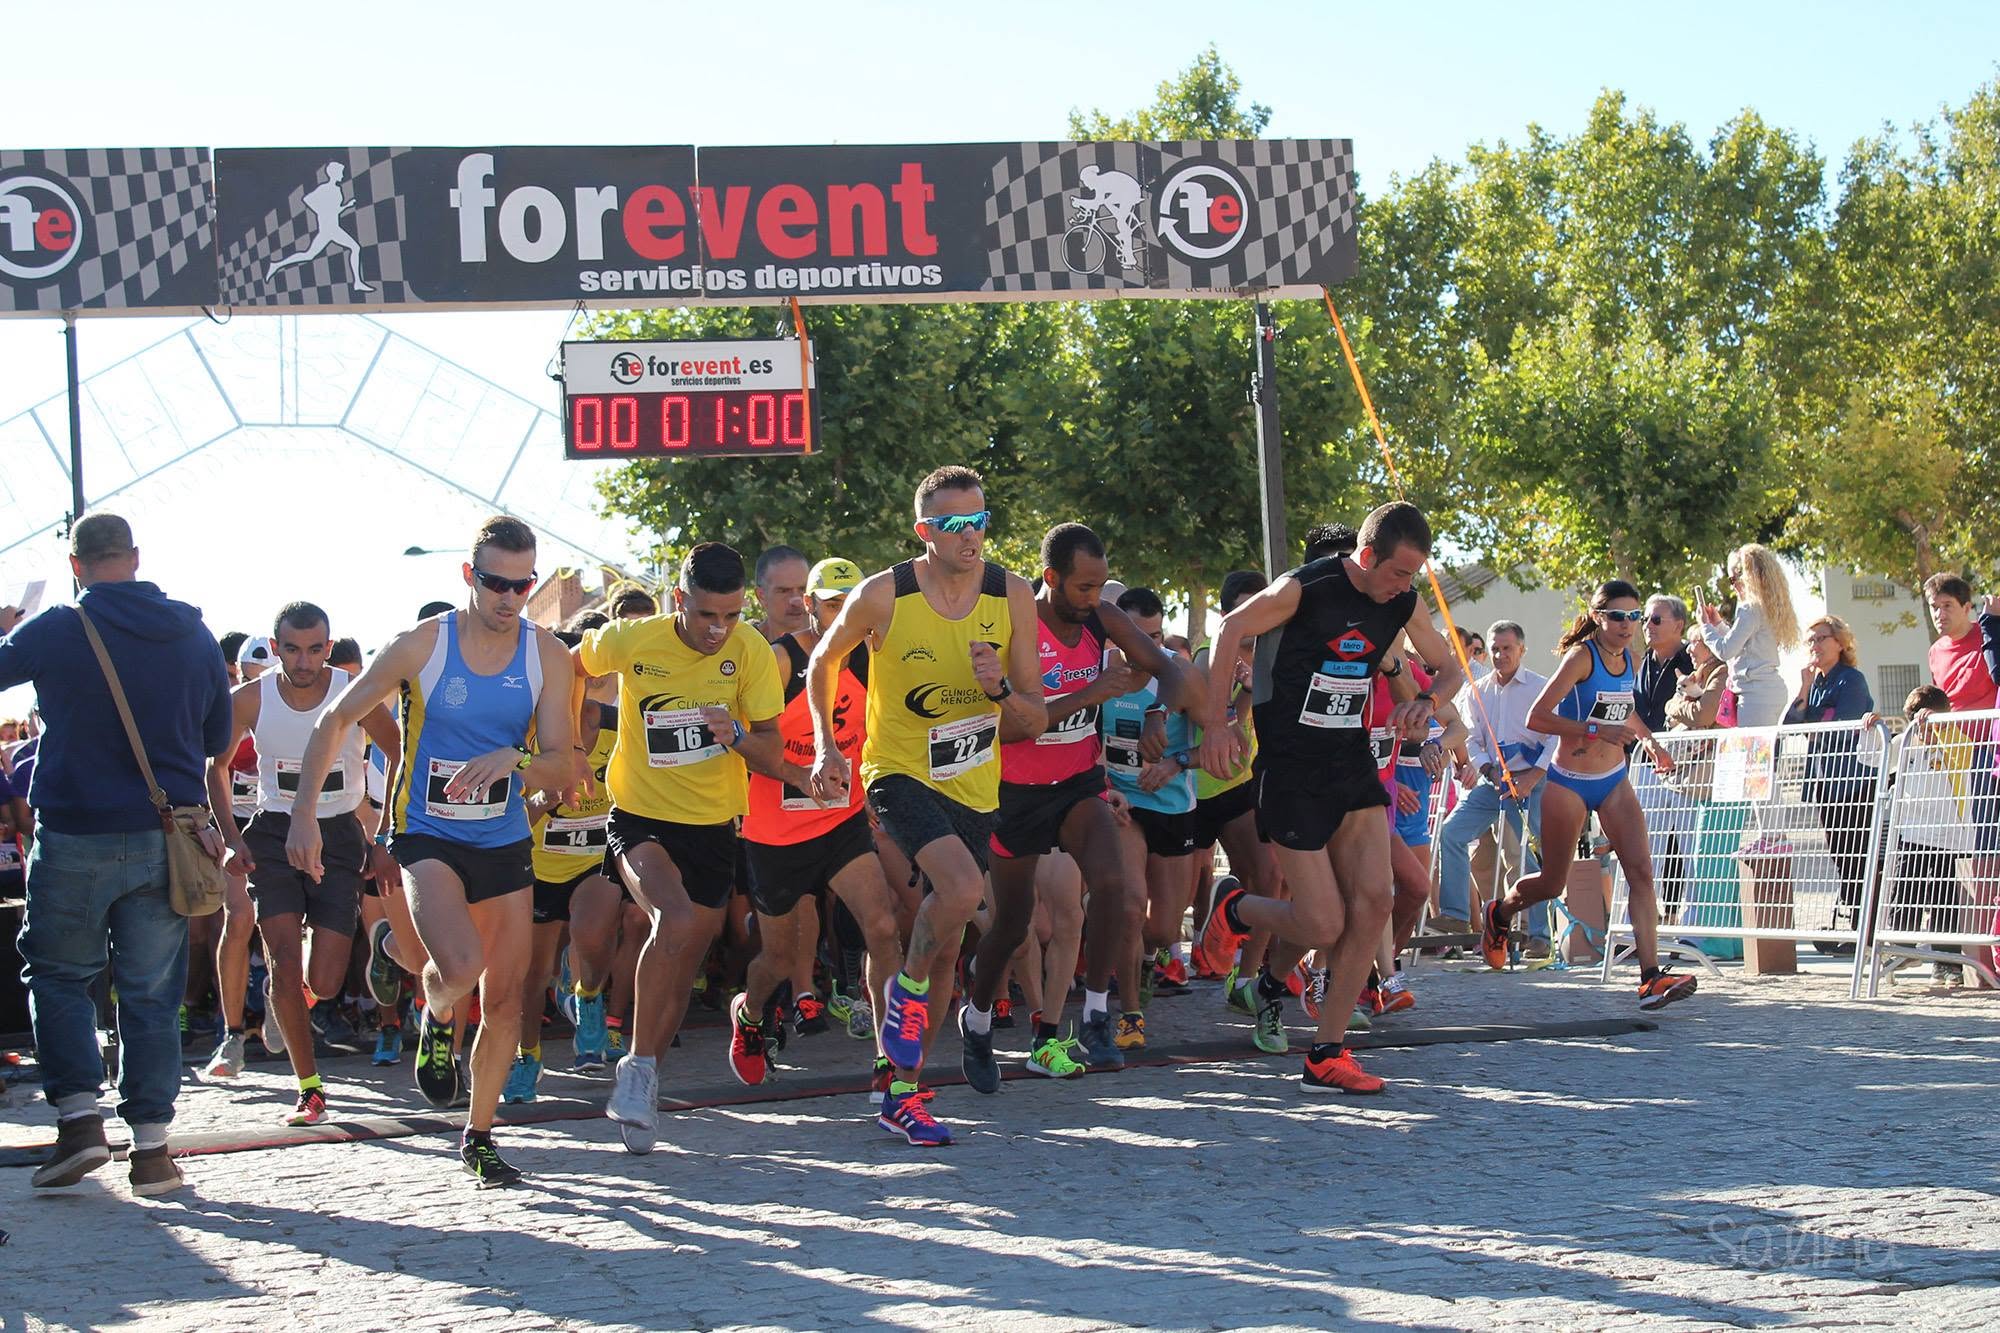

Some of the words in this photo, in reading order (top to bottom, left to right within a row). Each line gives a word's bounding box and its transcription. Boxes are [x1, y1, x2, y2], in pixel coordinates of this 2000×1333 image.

[450, 153, 938, 264] forevent
[579, 265, 747, 291] servicios
[755, 262, 943, 291] deportivos
[648, 356, 773, 377] forevent.es
[671, 376, 704, 386] servicios
[704, 375, 741, 386] deportivos
[1326, 694, 1352, 715] 35
[1604, 703, 1628, 720] 196
[673, 726, 702, 751] 16
[784, 739, 816, 756] Atletis
[954, 735, 978, 762] 22
[1127, 750, 1139, 766] 3
[566, 830, 588, 846] 14
